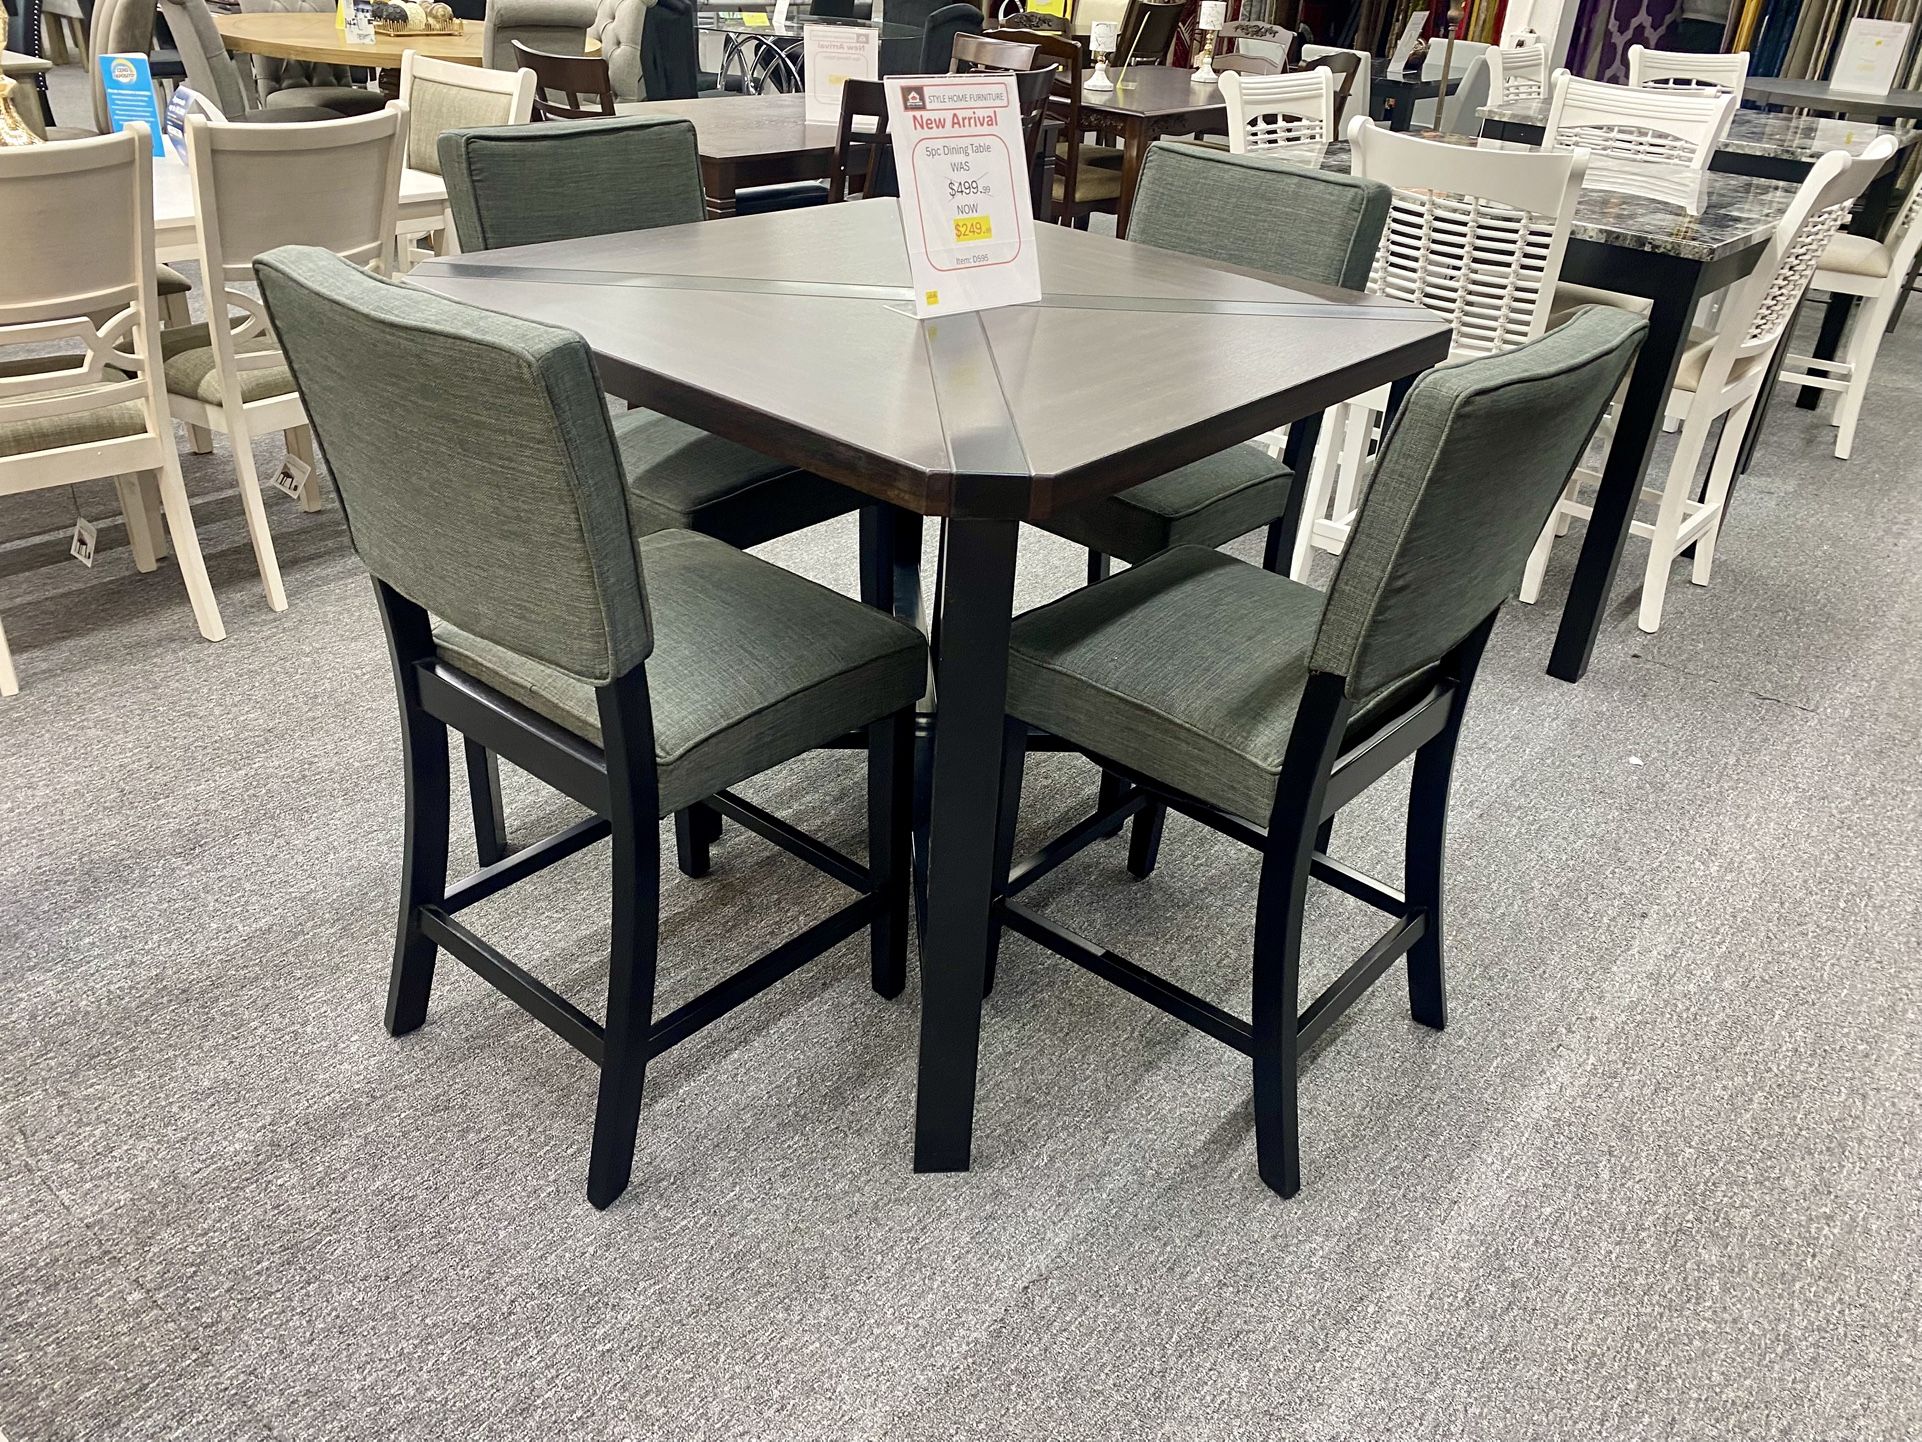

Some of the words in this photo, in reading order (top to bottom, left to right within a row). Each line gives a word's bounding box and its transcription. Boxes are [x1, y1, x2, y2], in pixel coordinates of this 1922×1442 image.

[928, 94, 946, 104] STYLE
[948, 93, 968, 103] HOME
[969, 92, 1005, 102] FURNITURE
[912, 114, 946, 131] New
[951, 109, 998, 129] Arrival
[925, 146, 941, 159] 5pc
[943, 144, 970, 157] Dining
[970, 143, 992, 153] Table
[950, 161, 970, 173] WAS
[948, 180, 991, 198] $499.99
[957, 203, 978, 215] NOW
[956, 255, 972, 265] Item:
[972, 253, 989, 263] D595
